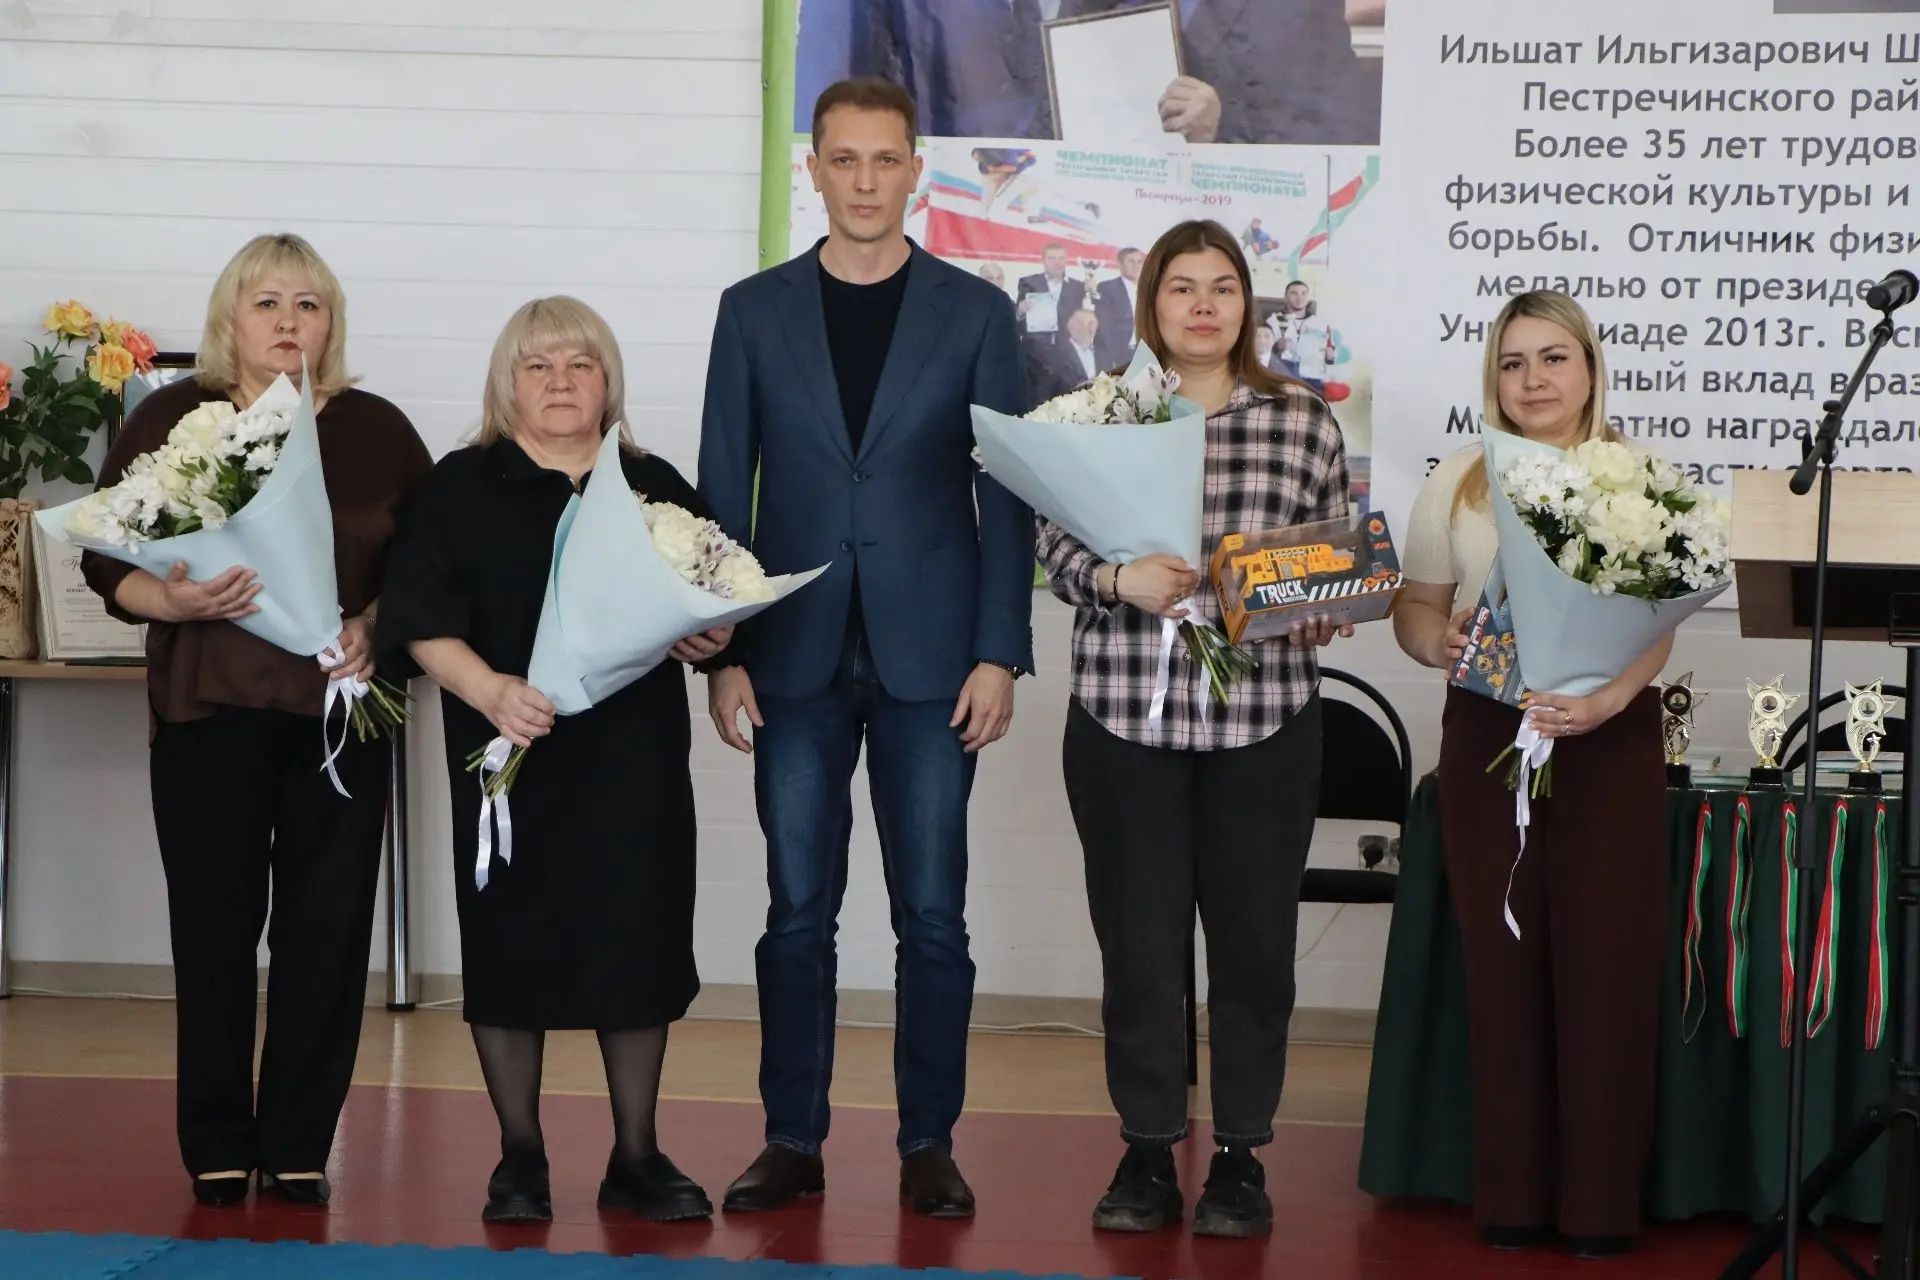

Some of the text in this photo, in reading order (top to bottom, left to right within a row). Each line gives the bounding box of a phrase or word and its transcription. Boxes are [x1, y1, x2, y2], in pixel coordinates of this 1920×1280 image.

[1440, 34, 1583, 65] Ильшат
[1597, 34, 1869, 72] Ильгизарович
[1522, 78, 1919, 120] Пестречинского рай
[1056, 149, 1168, 170] ЧЕМПИОНАТ
[1514, 128, 1920, 167] Более 35 лет трудов
[1191, 177, 1307, 197] ЧЕМПИОНАТЫ
[1201, 193, 1232, 206] 2019
[1445, 173, 1910, 214] физической культуры и
[1447, 220, 1600, 258] борьбы.
[1628, 222, 1815, 254] Отличник
[1476, 274, 1876, 308] медалью от президе
[1703, 316, 1826, 348] 2013г.
[1702, 370, 1815, 401] вклад
[1829, 371, 1849, 394] в
[1706, 415, 1920, 448] наградал
[1256, 579, 1306, 604] TRUCK
